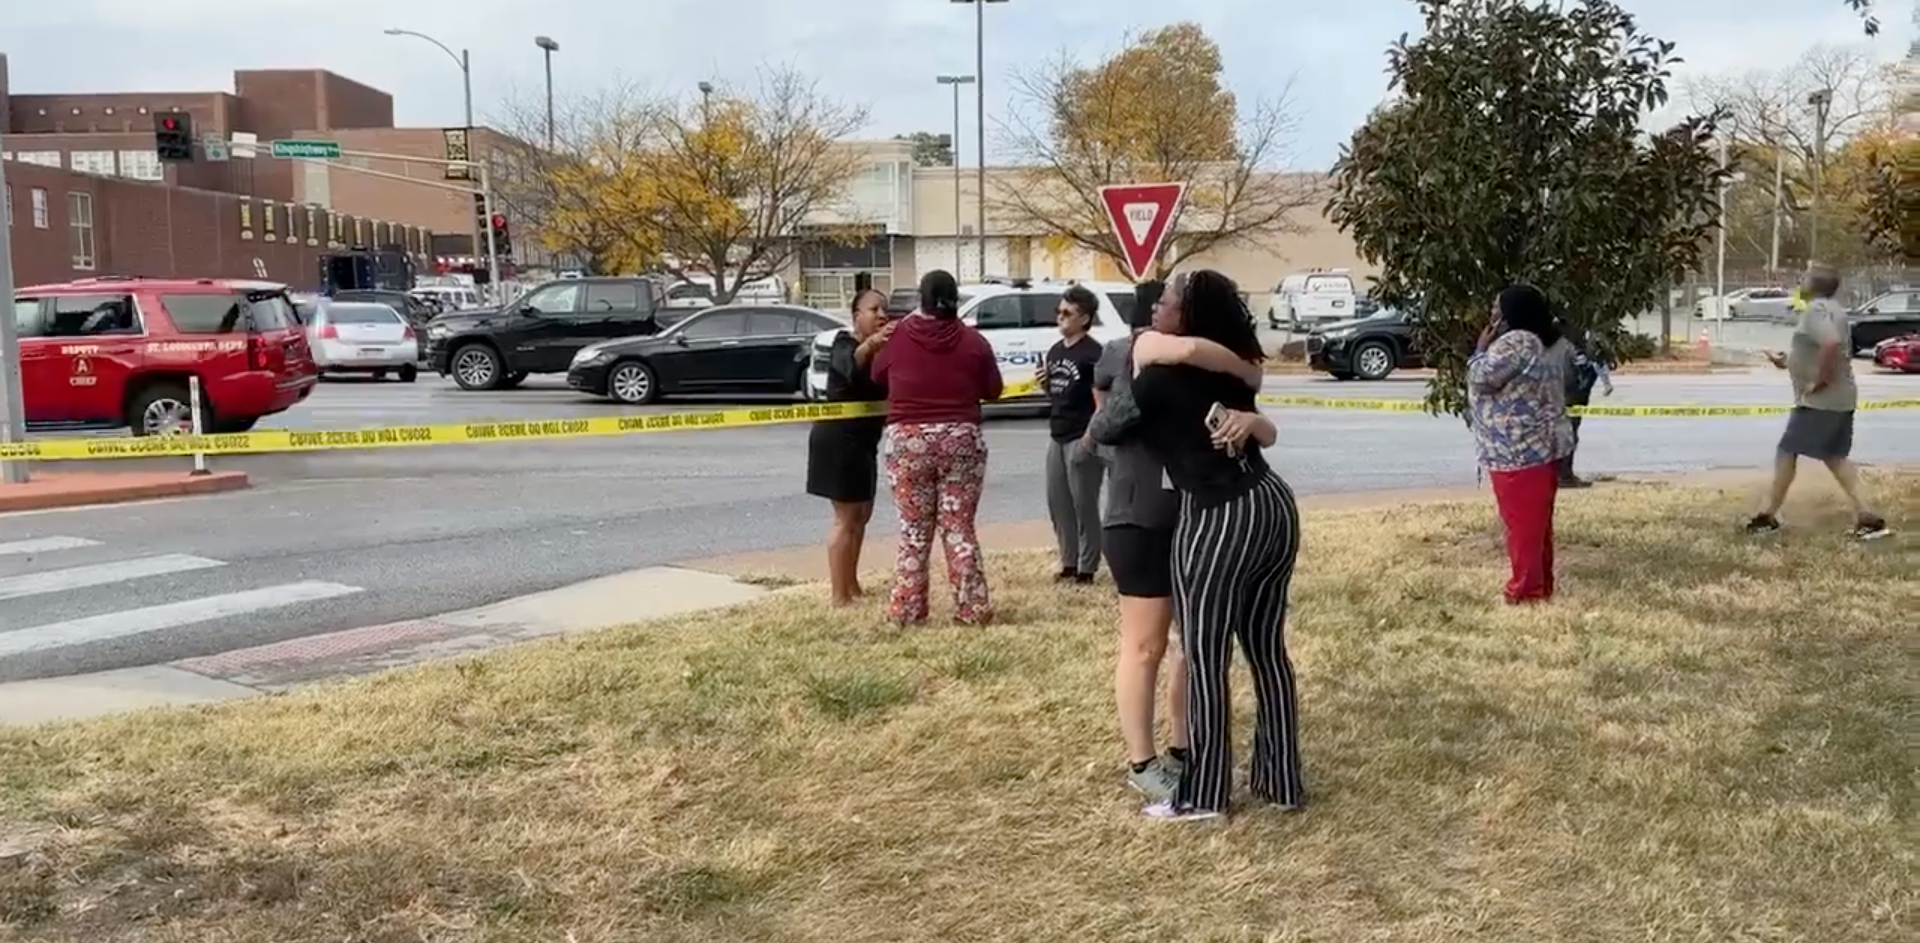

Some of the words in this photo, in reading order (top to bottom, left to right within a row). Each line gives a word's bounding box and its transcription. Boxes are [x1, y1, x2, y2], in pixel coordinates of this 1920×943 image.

[275, 143, 327, 156] Kingshighway
[1130, 209, 1153, 221] YIELD
[78, 359, 88, 373] A
